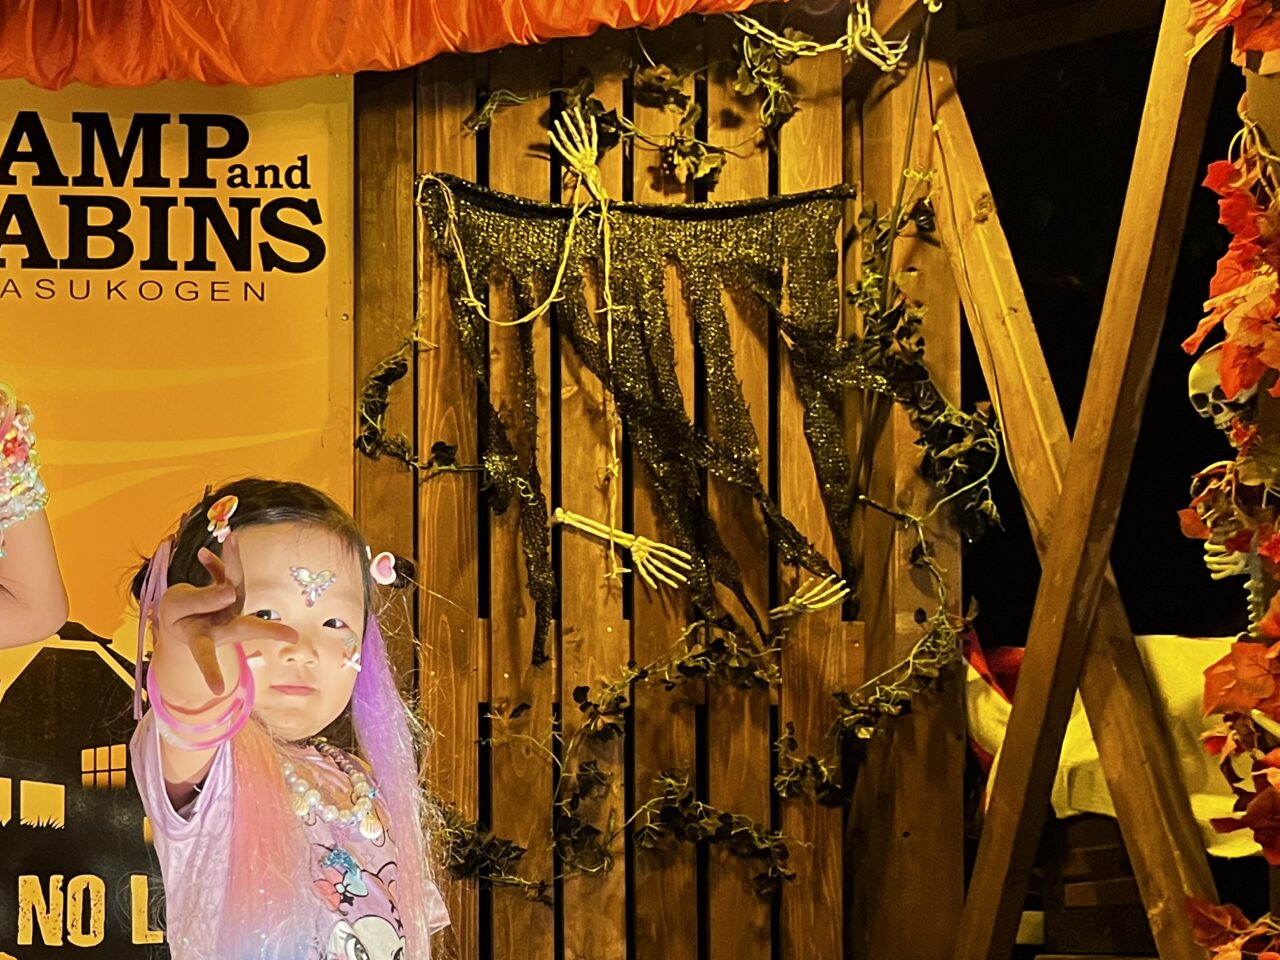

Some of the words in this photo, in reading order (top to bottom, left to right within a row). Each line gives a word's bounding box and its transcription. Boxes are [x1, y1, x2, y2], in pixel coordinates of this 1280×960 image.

[227, 155, 311, 190] and
[17, 874, 106, 947] NO
[130, 874, 164, 944] L
